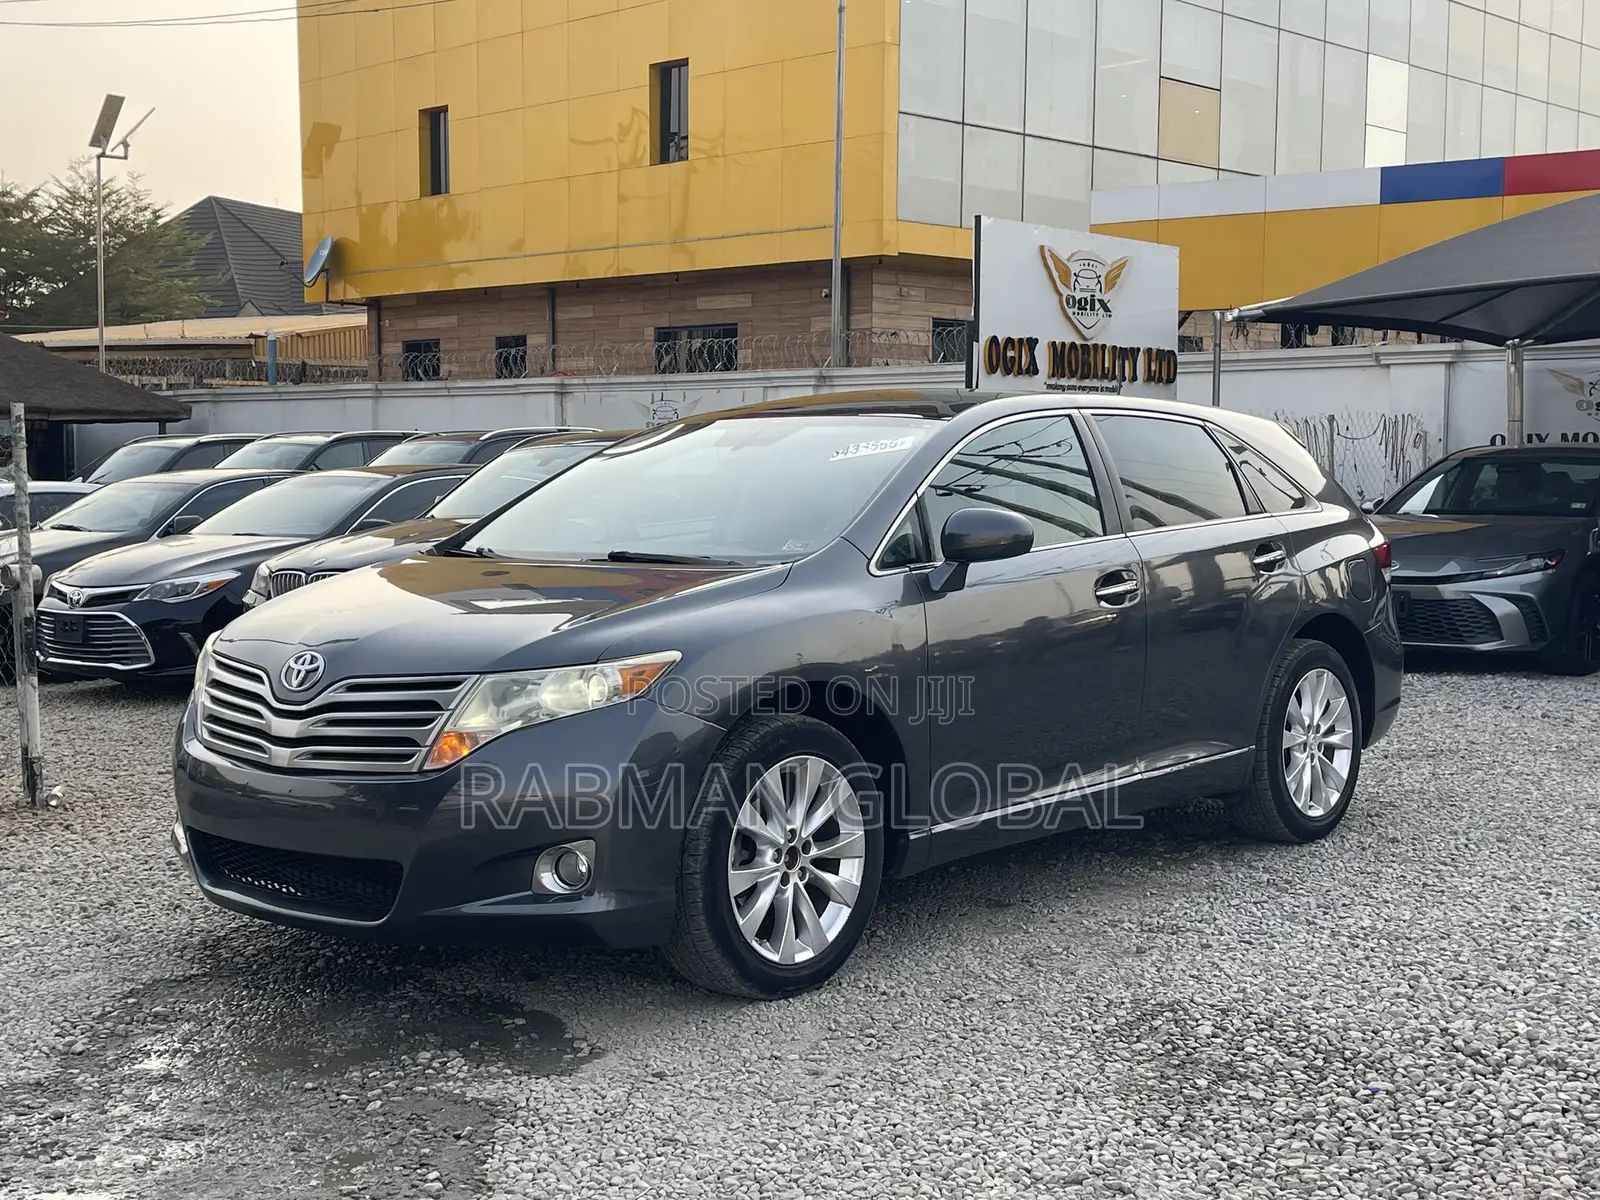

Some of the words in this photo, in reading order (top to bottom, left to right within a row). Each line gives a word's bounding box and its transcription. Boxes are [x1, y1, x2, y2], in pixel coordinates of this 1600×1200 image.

[1065, 294, 1112, 313] Ogix
[983, 335, 1040, 376] OGIX
[1047, 340, 1141, 382] MOBILITY
[1143, 346, 1178, 384] LTD
